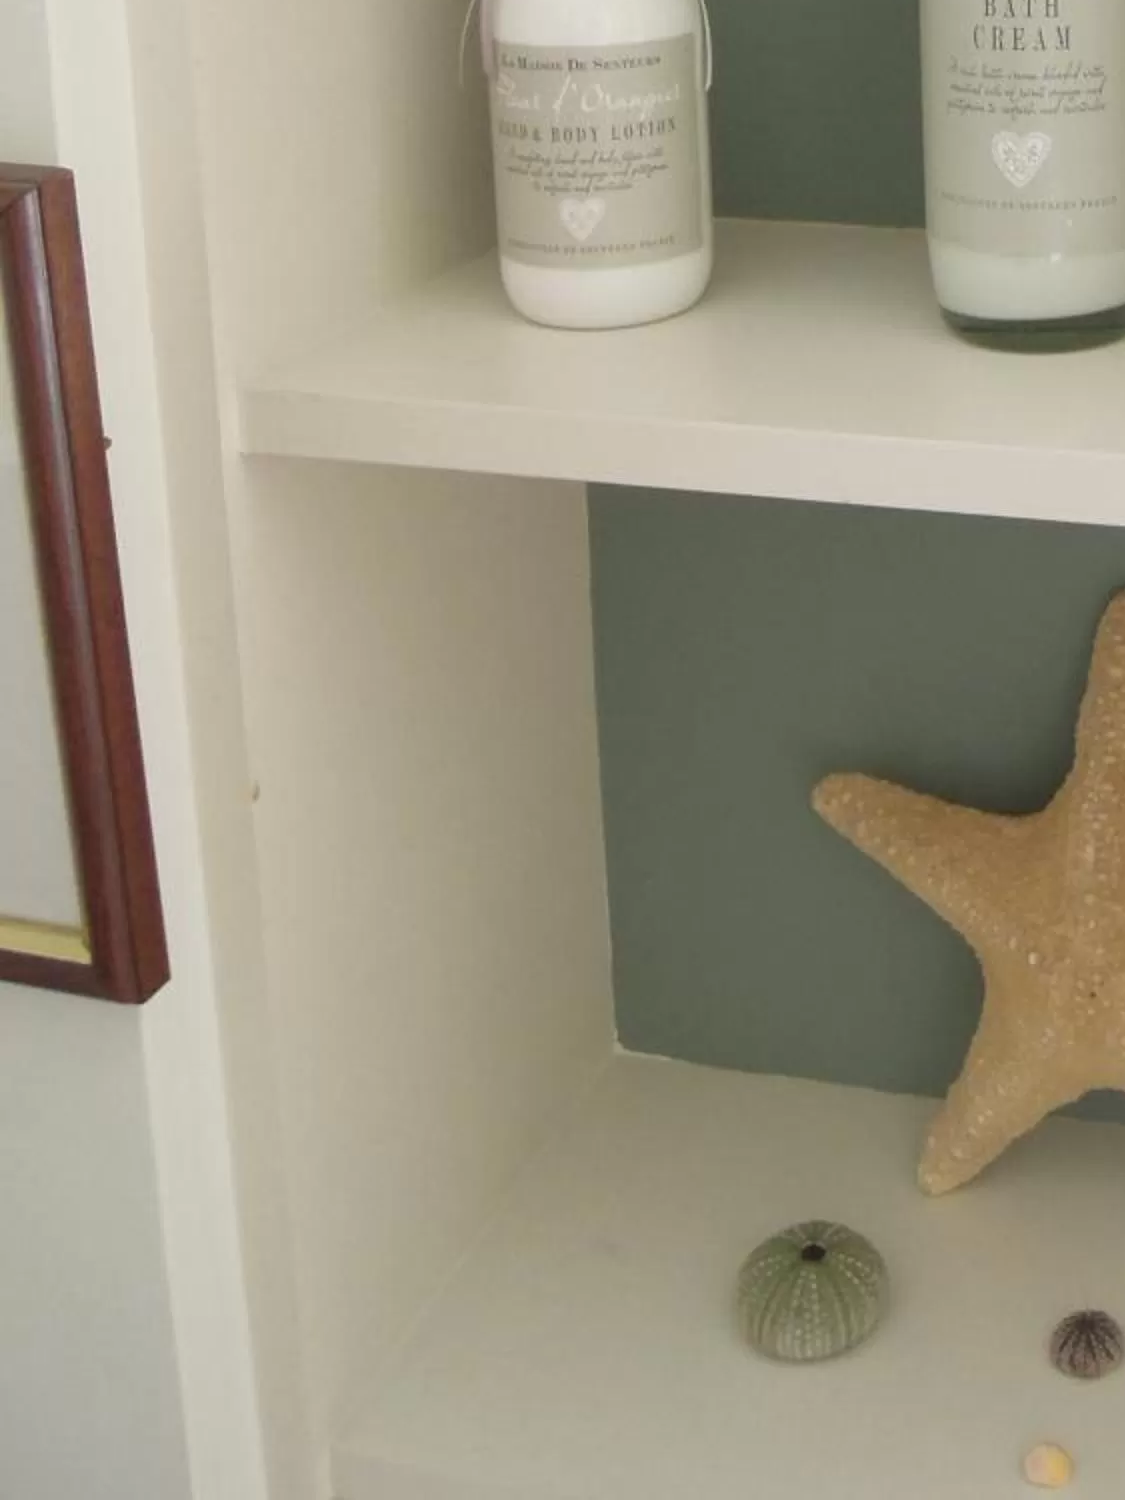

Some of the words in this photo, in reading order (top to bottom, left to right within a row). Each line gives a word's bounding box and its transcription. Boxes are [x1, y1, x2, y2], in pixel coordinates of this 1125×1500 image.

[972, 24, 1072, 51] CREAM
[551, 126, 600, 144] BODY
[610, 116, 677, 142] LOTION
